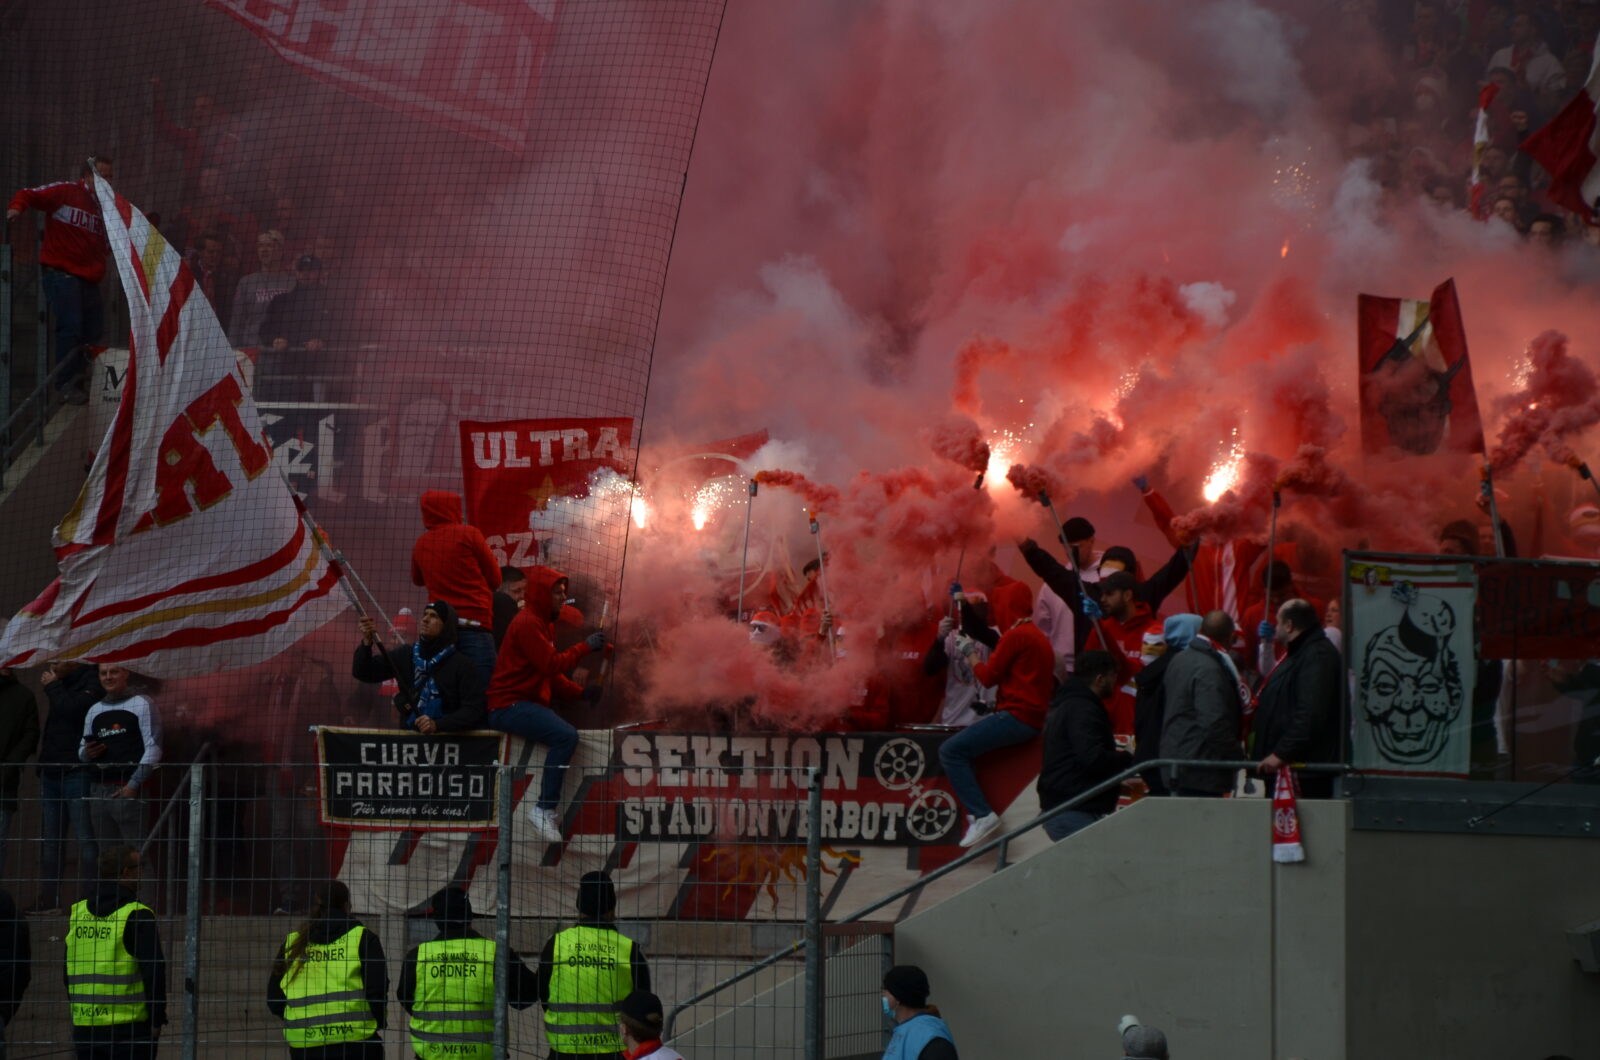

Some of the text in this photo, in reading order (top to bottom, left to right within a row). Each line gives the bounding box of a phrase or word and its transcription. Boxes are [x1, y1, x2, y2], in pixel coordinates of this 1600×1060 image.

[471, 427, 624, 469] ULTRA
[360, 742, 460, 766] CURVA
[621, 734, 864, 790] SEKTION
[380, 803, 417, 816] immer
[421, 803, 439, 816] bei
[624, 796, 904, 841] STADIONVERBOT
[76, 926, 112, 939] ORDNER
[303, 947, 345, 963] RDNER
[430, 964, 477, 978] ORDNER
[568, 956, 615, 971] ORDNER
[444, 1044, 478, 1055] MEWA
